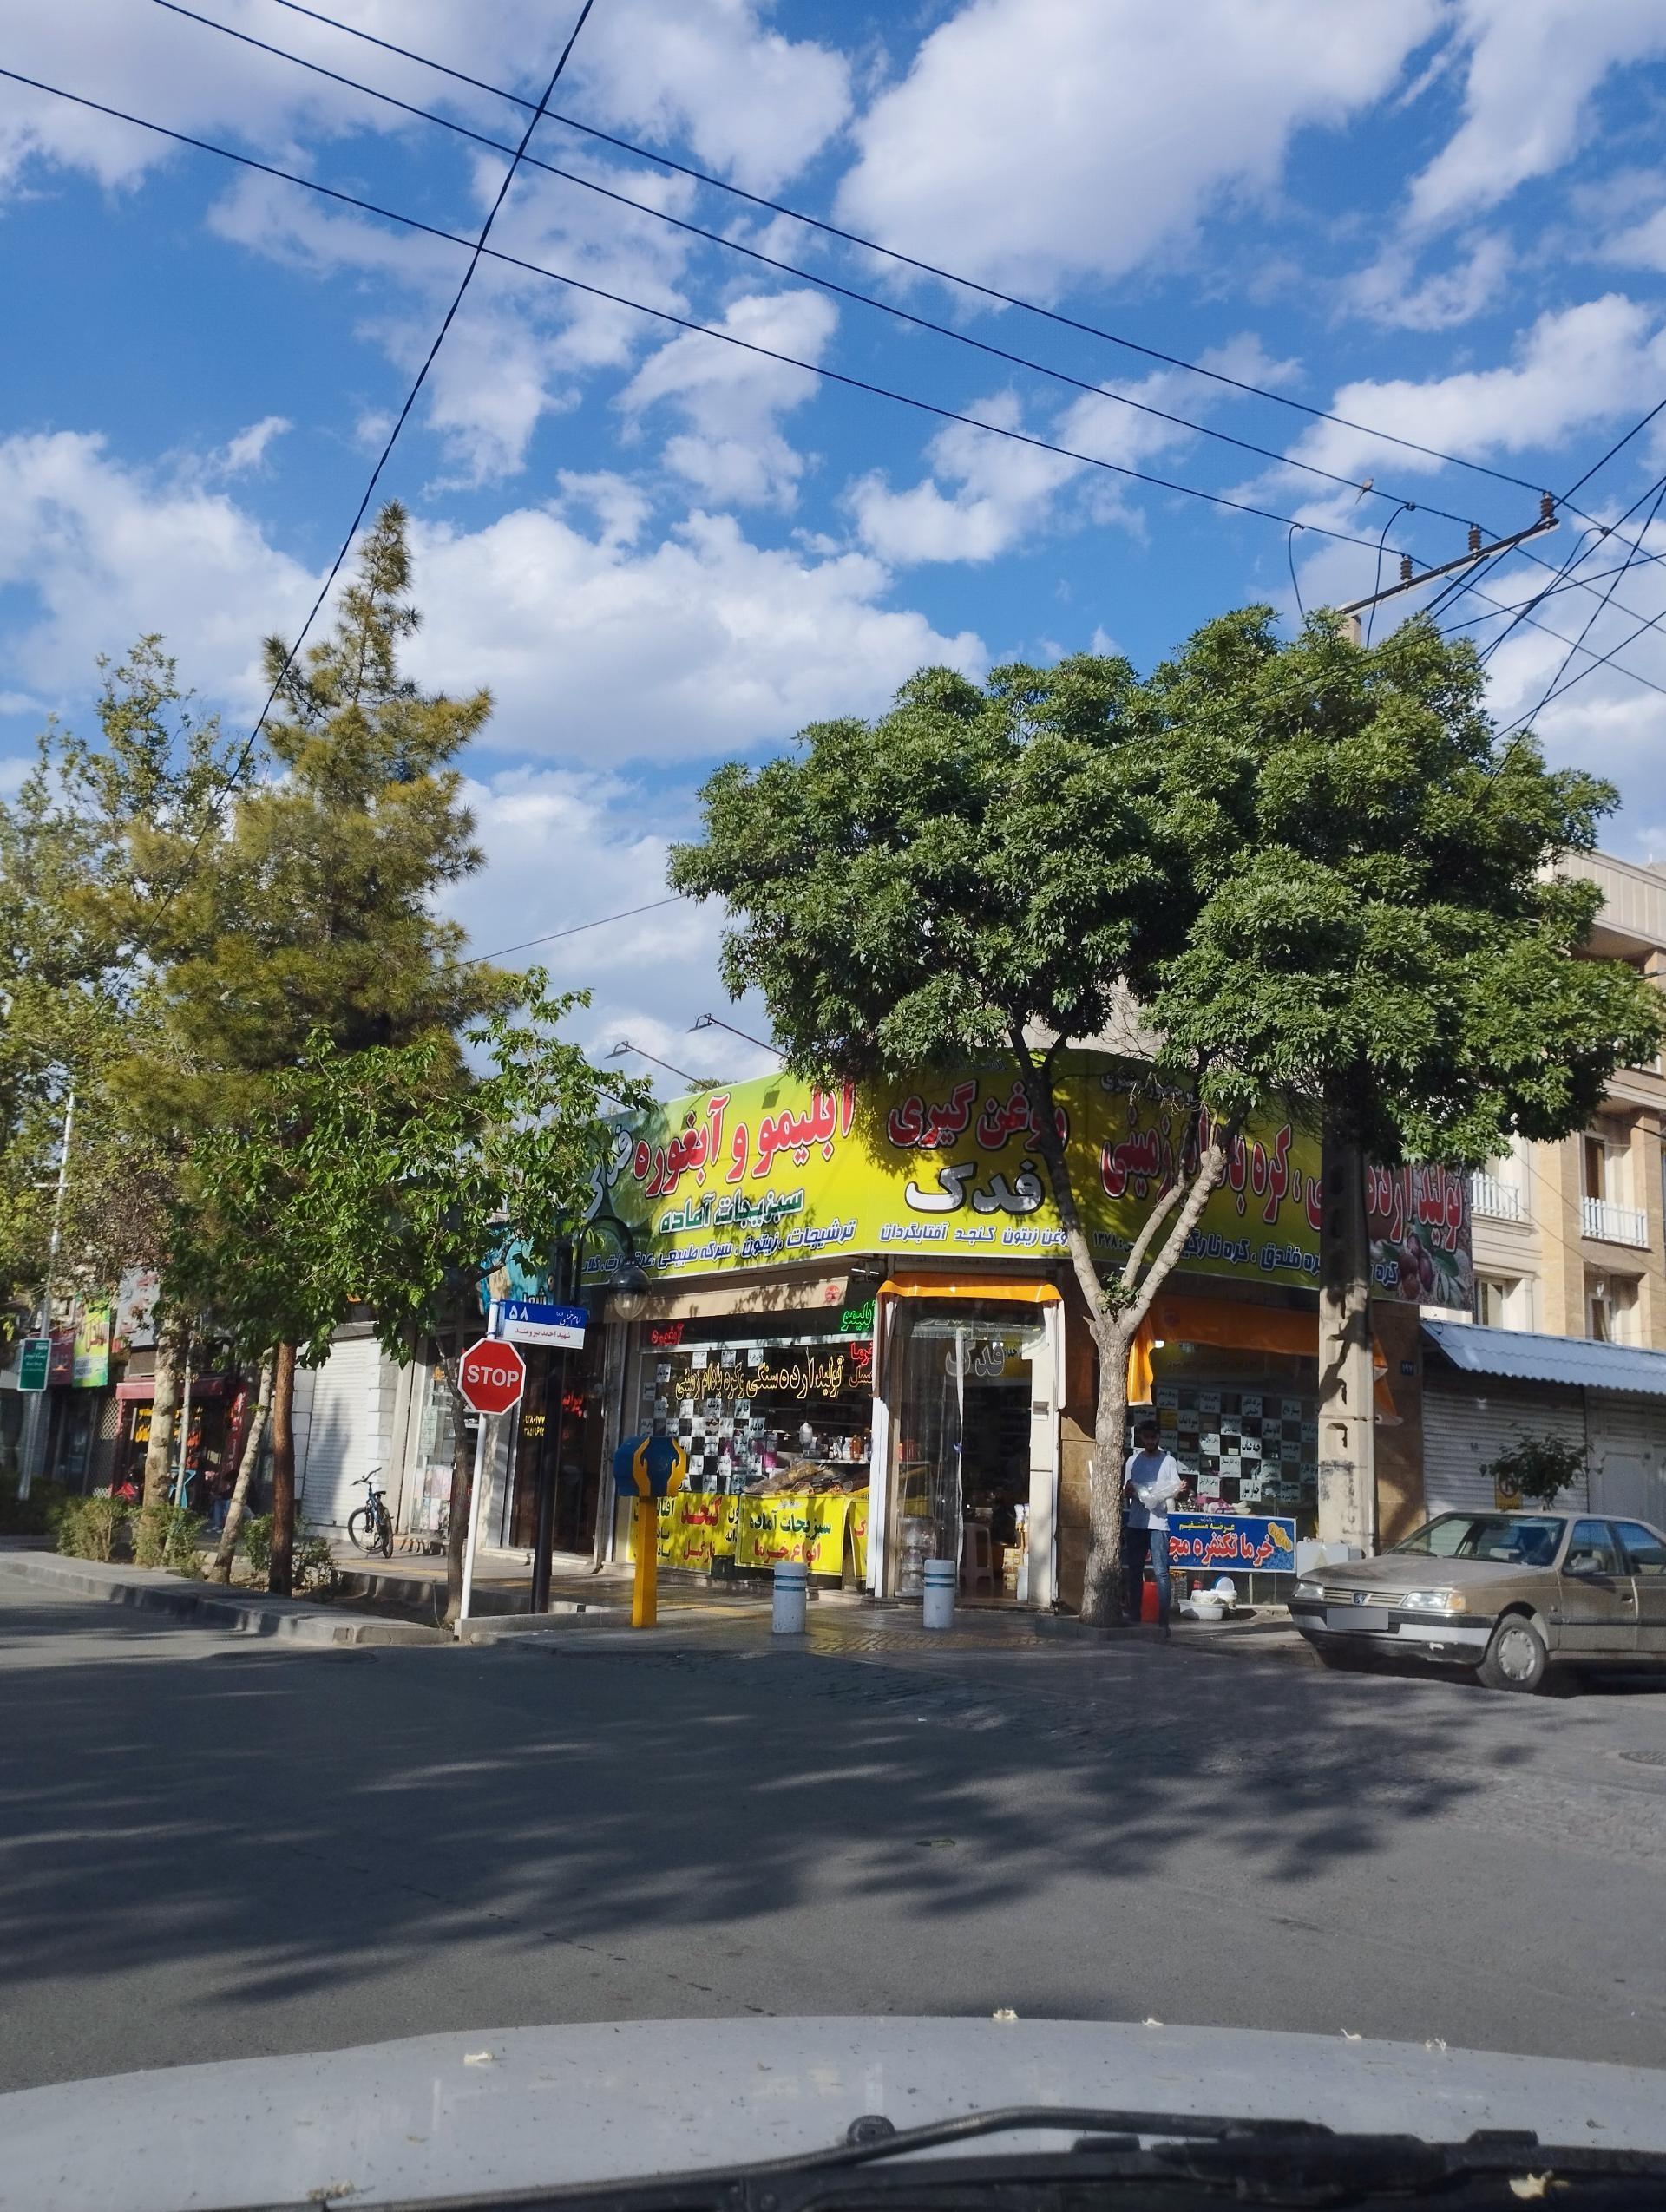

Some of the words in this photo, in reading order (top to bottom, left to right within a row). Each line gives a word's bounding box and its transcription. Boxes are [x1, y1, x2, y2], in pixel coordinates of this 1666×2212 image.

[888, 1079, 976, 1148] گیری
[633, 1092, 731, 1198] آبغوره
[725, 1122, 750, 1183] و
[905, 1159, 1046, 1214] فدک
[1252, 1124, 1292, 1224] کره
[659, 1193, 715, 1234] آماده
[713, 1188, 804, 1230] سبزیجات
[1418, 1165, 1464, 1253] تولید
[879, 1221, 950, 1244] آفتابگردان
[954, 1226, 996, 1246] کنجد
[1001, 1226, 1040, 1247] زیتون
[1223, 1238, 1250, 1265] کره
[1260, 1241, 1302, 1272] فندق
[1303, 1249, 1321, 1276] ره
[509, 1305, 528, 1322] ۵۸
[557, 1332, 571, 1340] شهید
[466, 1365, 520, 1388] STOP
[746, 1362, 779, 1398] سنگی
[815, 1356, 845, 1397] تولید
[750, 1509, 778, 1532] آماده
[780, 1512, 831, 1541] سبزیجات
[1179, 1521, 1209, 1531] مستقیم
[754, 1538, 789, 1564] خرما
[791, 1541, 821, 1567] انواع
[1194, 1532, 1238, 1566] تکنفره
[1241, 1533, 1275, 1567] خرما
